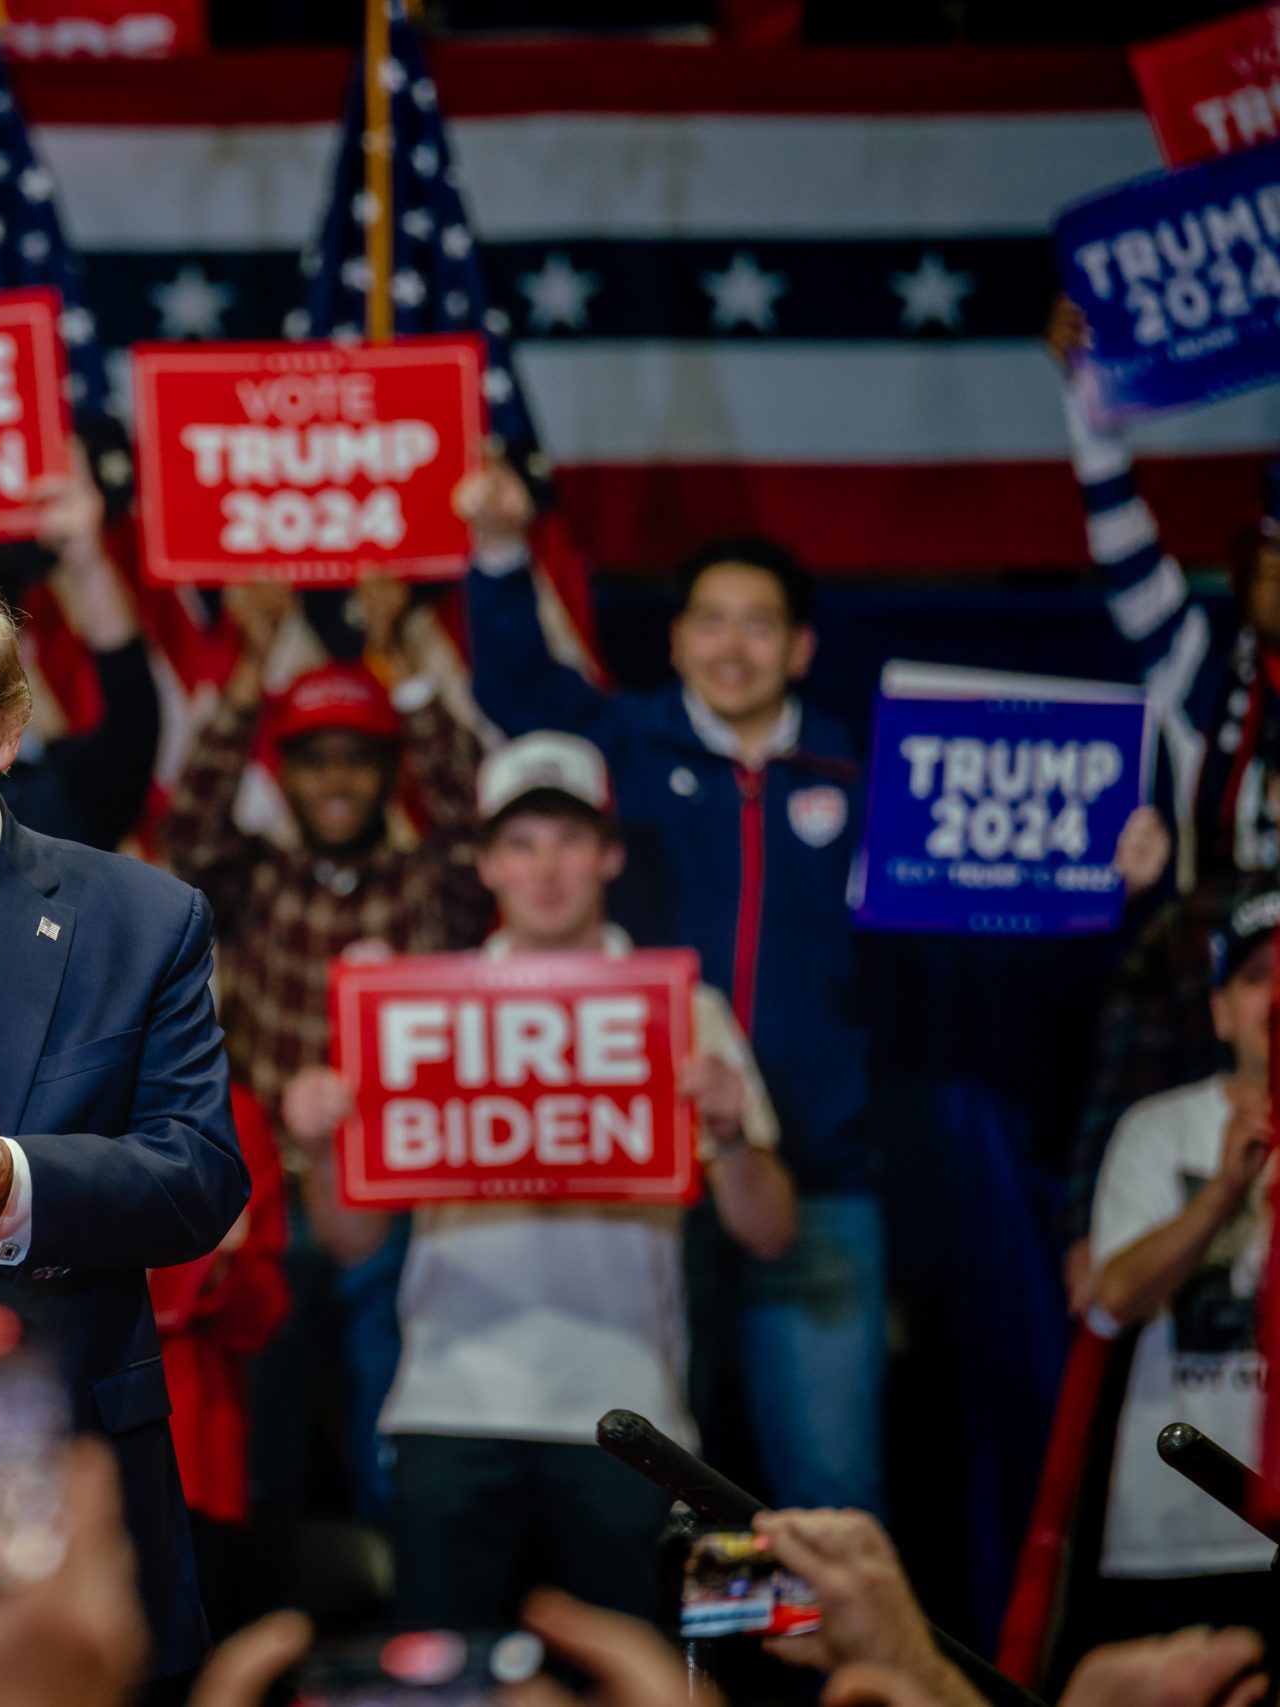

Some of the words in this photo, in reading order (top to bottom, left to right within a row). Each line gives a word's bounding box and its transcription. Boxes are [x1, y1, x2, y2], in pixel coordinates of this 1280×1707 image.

[235, 374, 376, 424] VOTE
[179, 420, 439, 488] TRUMP
[221, 488, 406, 552] 2024
[899, 734, 1123, 804] TRUMP
[925, 797, 1090, 861] 2024
[375, 996, 651, 1090] FIRE
[381, 1094, 655, 1170] BIDEN
